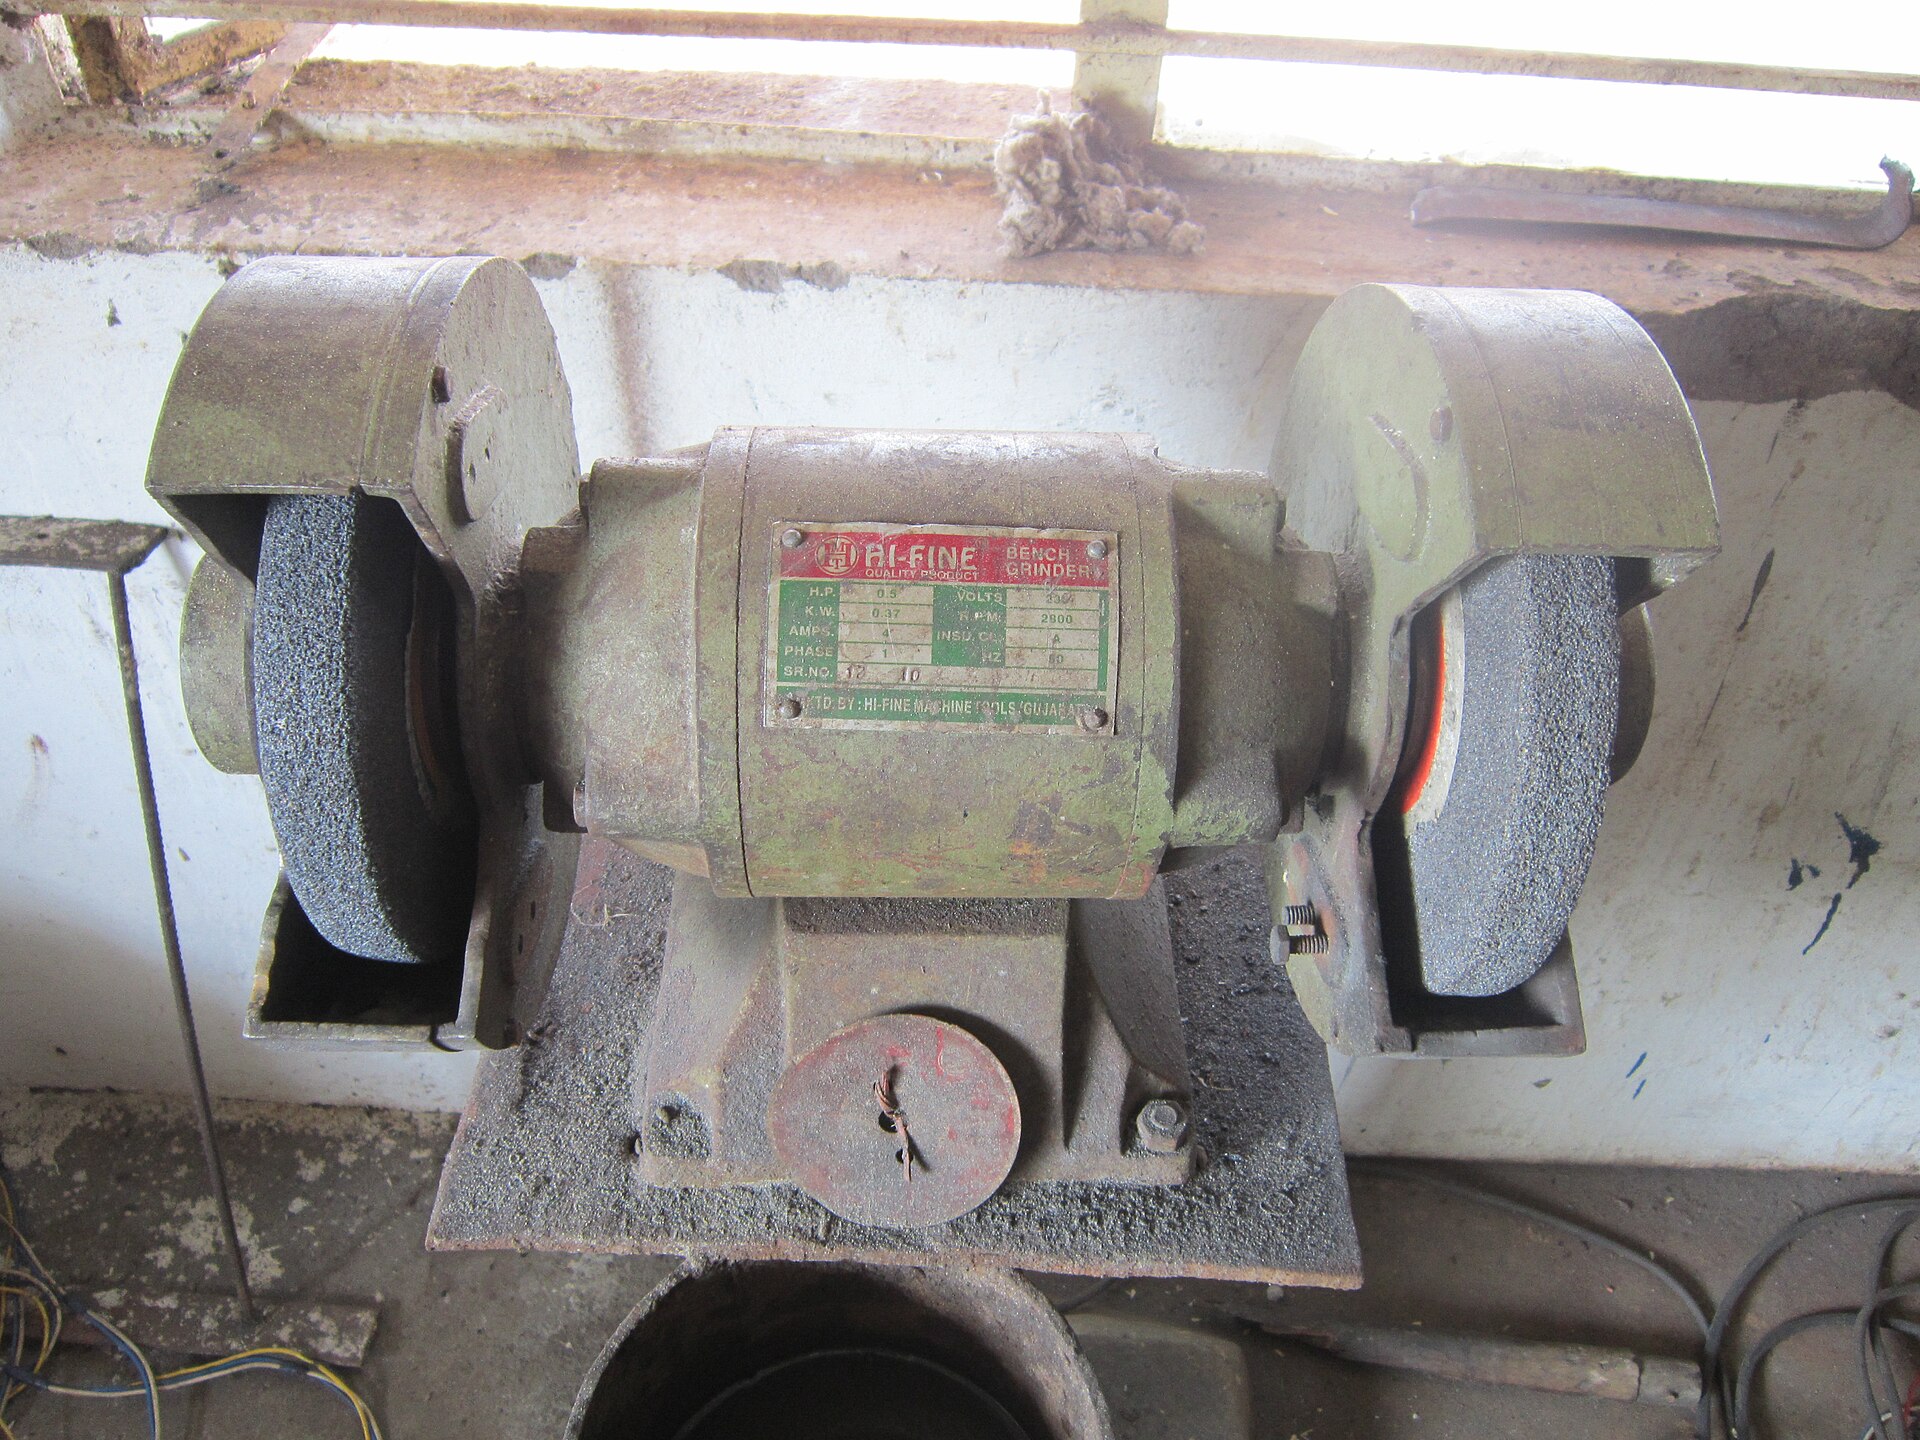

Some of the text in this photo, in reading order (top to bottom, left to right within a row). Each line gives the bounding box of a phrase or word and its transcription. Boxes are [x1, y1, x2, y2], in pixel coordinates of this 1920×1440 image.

[865, 543, 977, 570] HI-FINE
[1006, 546, 1070, 561] BENCH
[865, 568, 979, 581] QUALITY PRODUCT
[1006, 562, 1090, 579] GRINDER
[810, 587, 836, 597] H.P.
[877, 589, 897, 599] 0.5
[957, 590, 1003, 602] VOLTS
[805, 606, 836, 616] K.W.
[872, 608, 901, 618] 0.37
[1041, 613, 1073, 624] 2800
[789, 624, 834, 636] AMPS.
[1053, 634, 1061, 644] A
[784, 645, 834, 657] PHASE
[882, 648, 888, 658] 1
[784, 665, 833, 677] SR.NO.
[864, 697, 911, 712] HI-FINE
[914, 699, 972, 715] MACHINE
